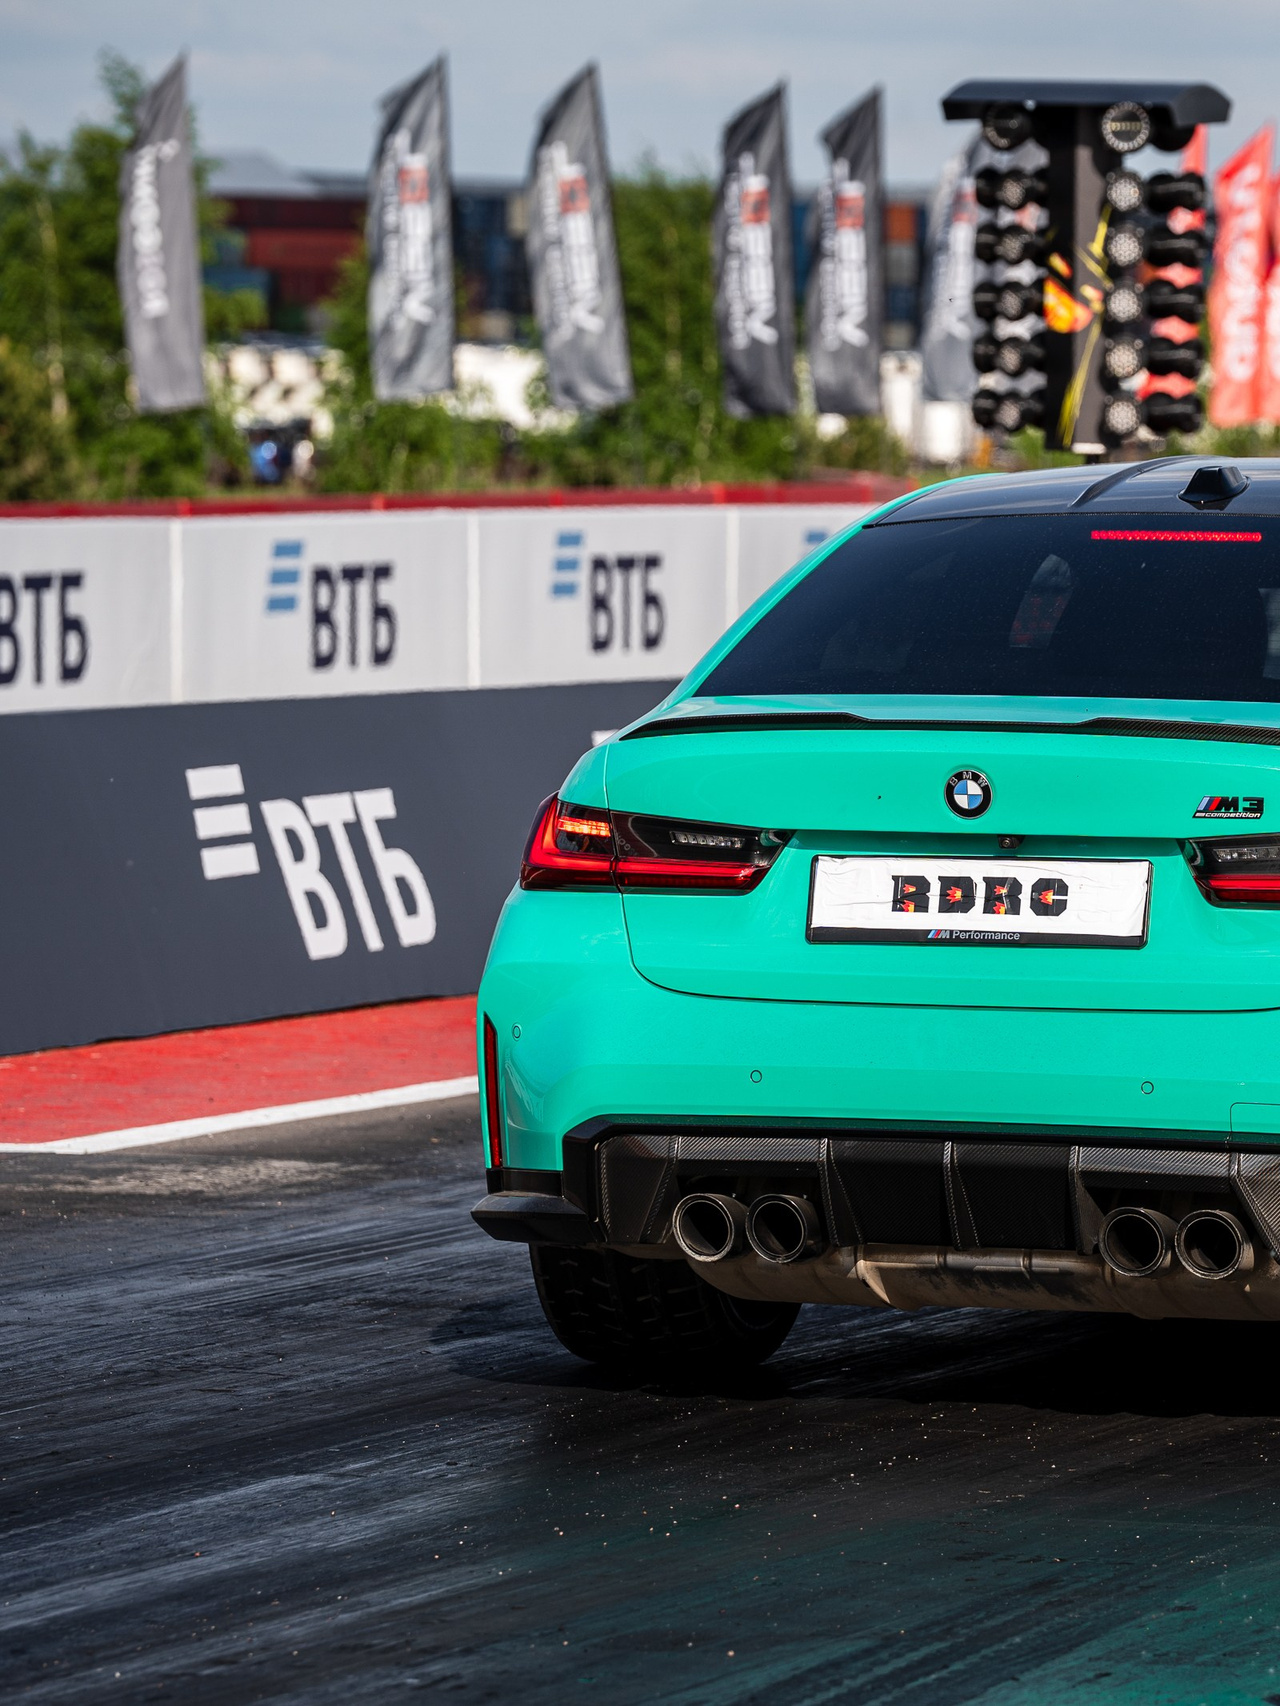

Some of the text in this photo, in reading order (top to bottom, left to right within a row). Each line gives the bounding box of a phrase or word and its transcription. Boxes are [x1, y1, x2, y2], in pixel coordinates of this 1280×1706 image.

[311, 562, 396, 669] ВТБ
[592, 554, 664, 652] ВТБ
[949, 771, 988, 788] BMW
[1205, 811, 1261, 819] competition
[1214, 796, 1264, 811] M3
[259, 786, 437, 961] ВТБ
[891, 874, 1069, 917] RDRC
[952, 930, 1020, 941] Performance
